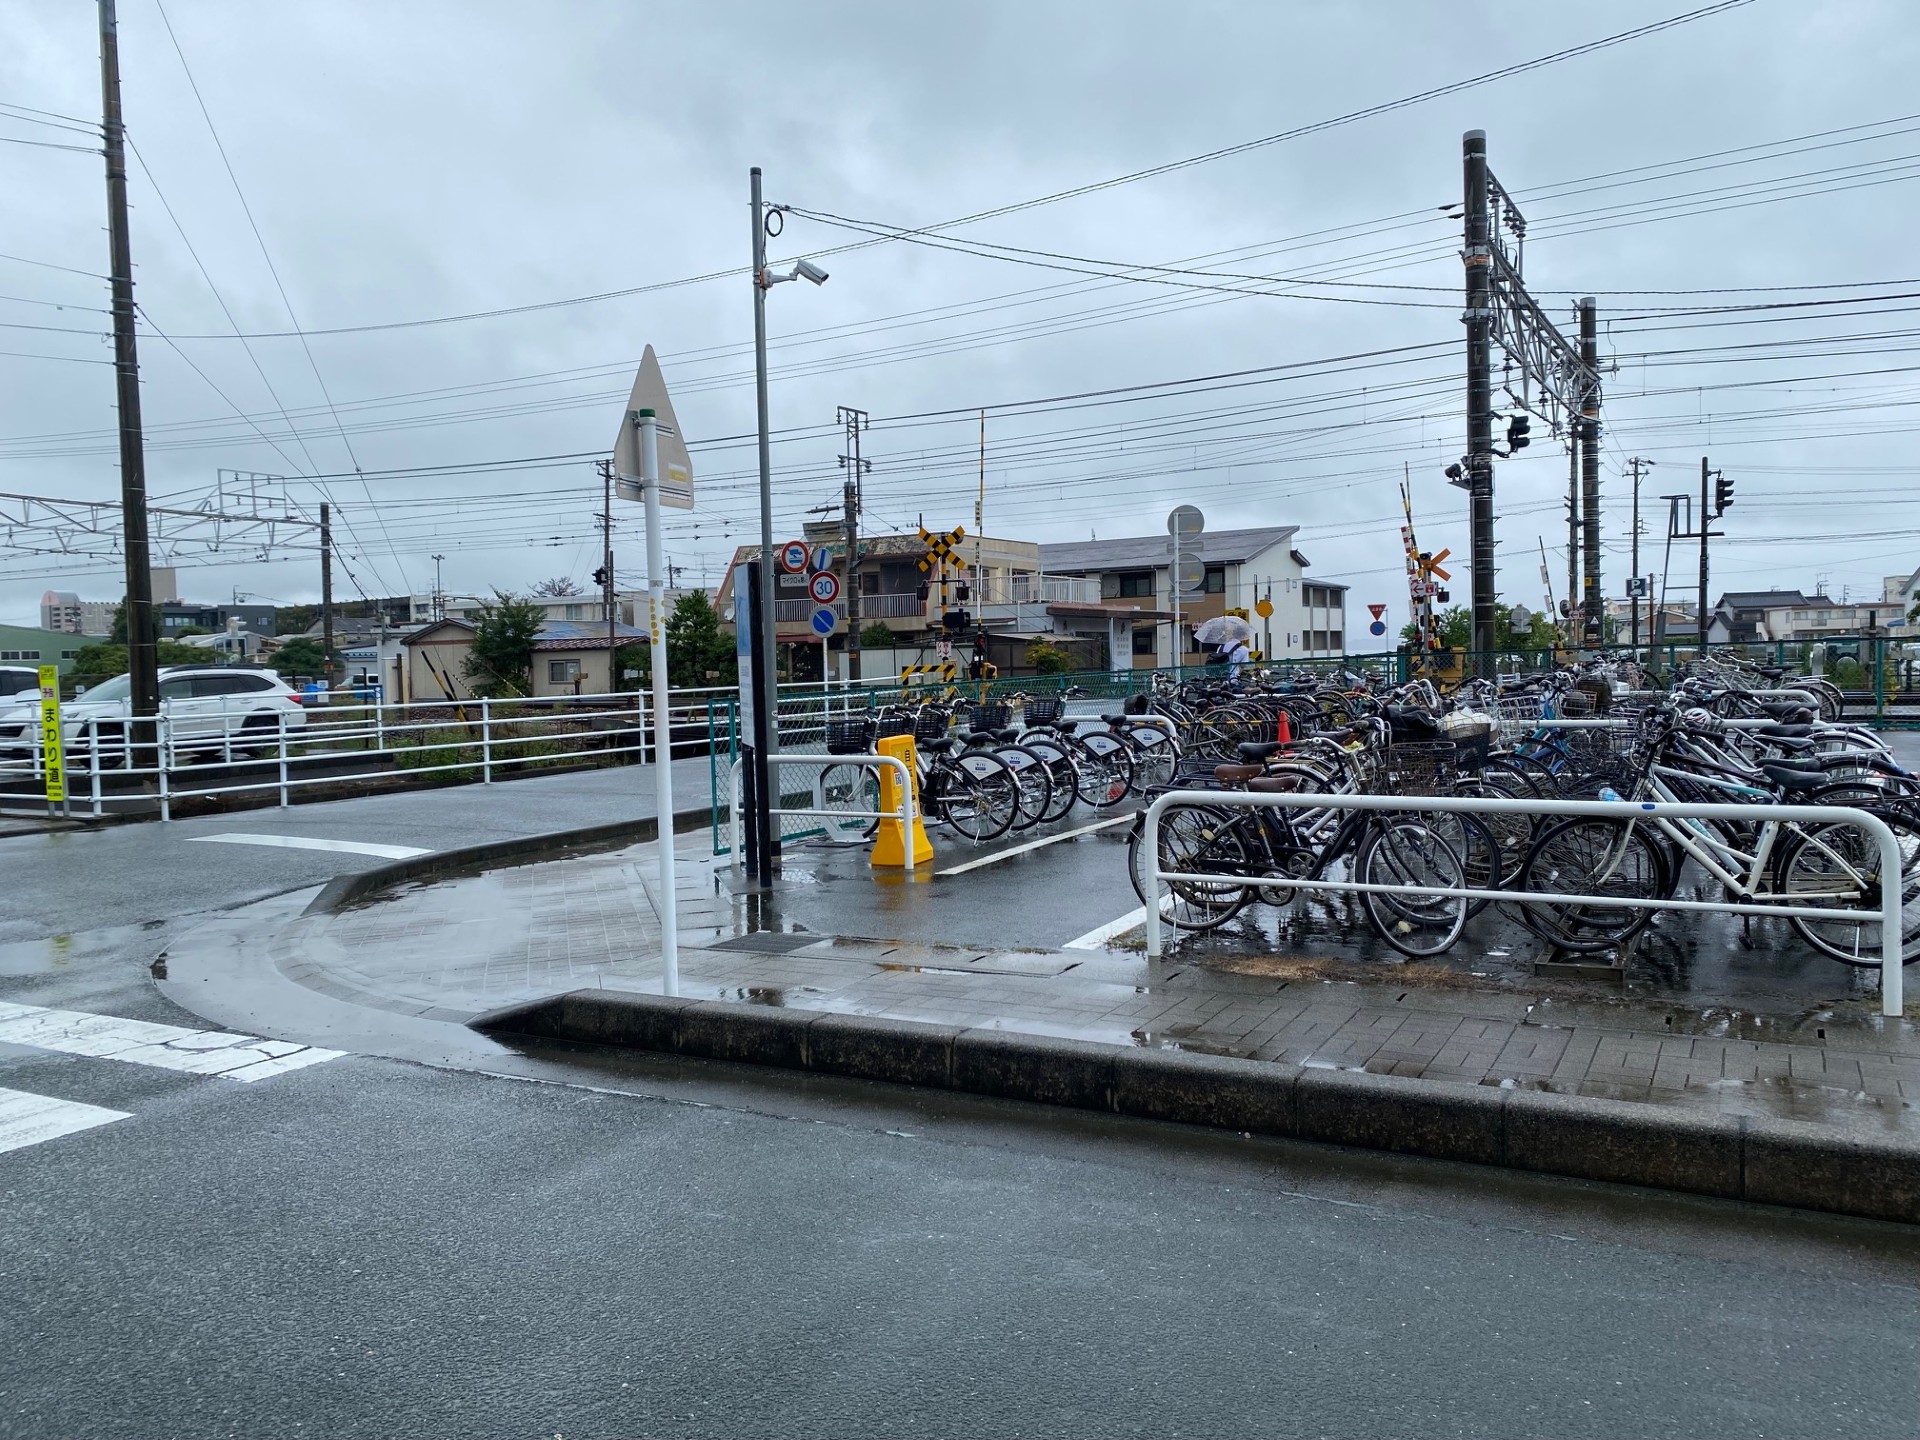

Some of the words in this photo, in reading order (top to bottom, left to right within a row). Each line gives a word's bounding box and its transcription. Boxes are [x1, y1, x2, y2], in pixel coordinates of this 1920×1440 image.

[816, 581, 832, 595] 30
[1631, 579, 1641, 589] P
[45, 707, 60, 783] まわり道
